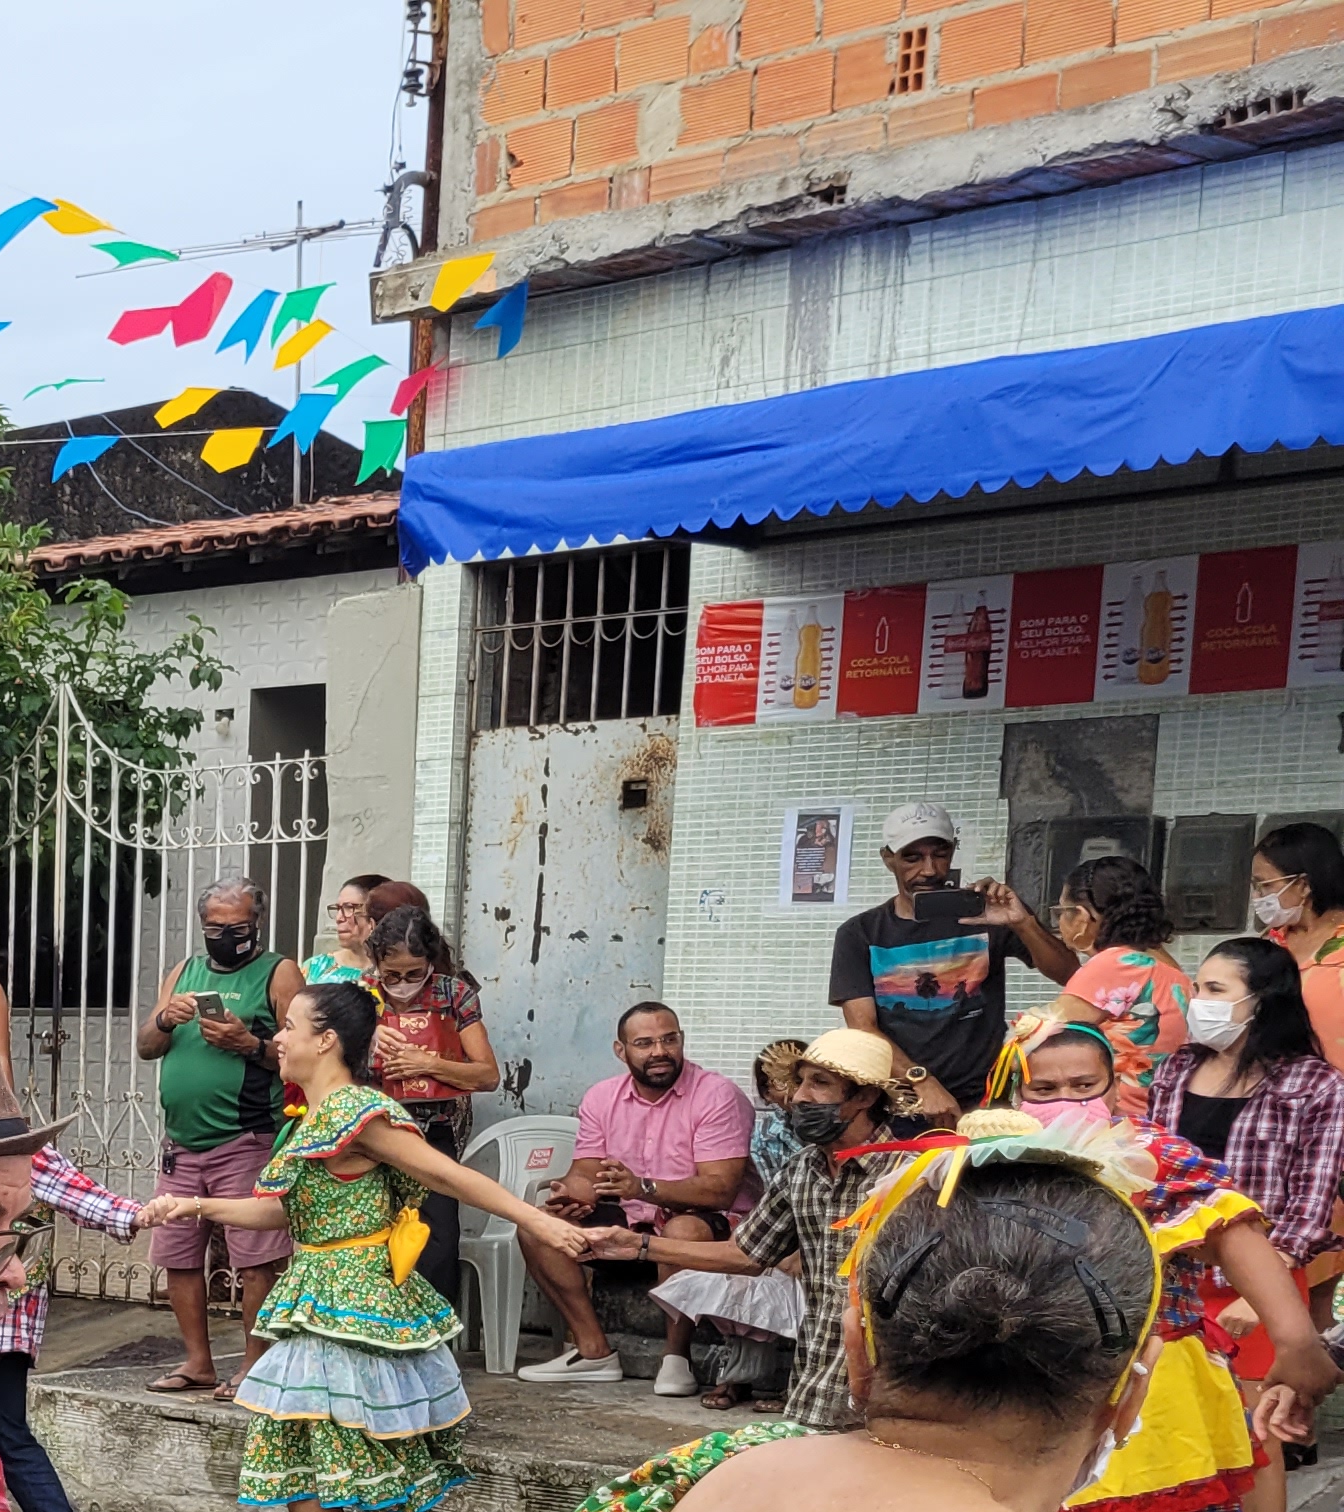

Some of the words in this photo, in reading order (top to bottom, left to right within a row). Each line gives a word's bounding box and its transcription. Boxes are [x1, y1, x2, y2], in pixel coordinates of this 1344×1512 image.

[1019, 618, 1045, 628] BOM
[1047, 616, 1078, 626] PARA
[1079, 614, 1088, 623] O
[1021, 629, 1043, 639] SEU
[1206, 624, 1277, 638] COCA-COLA
[1014, 637, 1059, 649] MELHOR
[1061, 635, 1091, 646] PARA
[717, 644, 742, 655] PARA
[744, 643, 752, 652] O
[1020, 650, 1029, 658] O
[851, 656, 909, 667] COCA-COLA
[697, 664, 727, 675] ELHOR
[728, 662, 754, 673] PARA
[845, 665, 913, 679] RETORNÁVEL
[352, 808, 376, 839] 39
